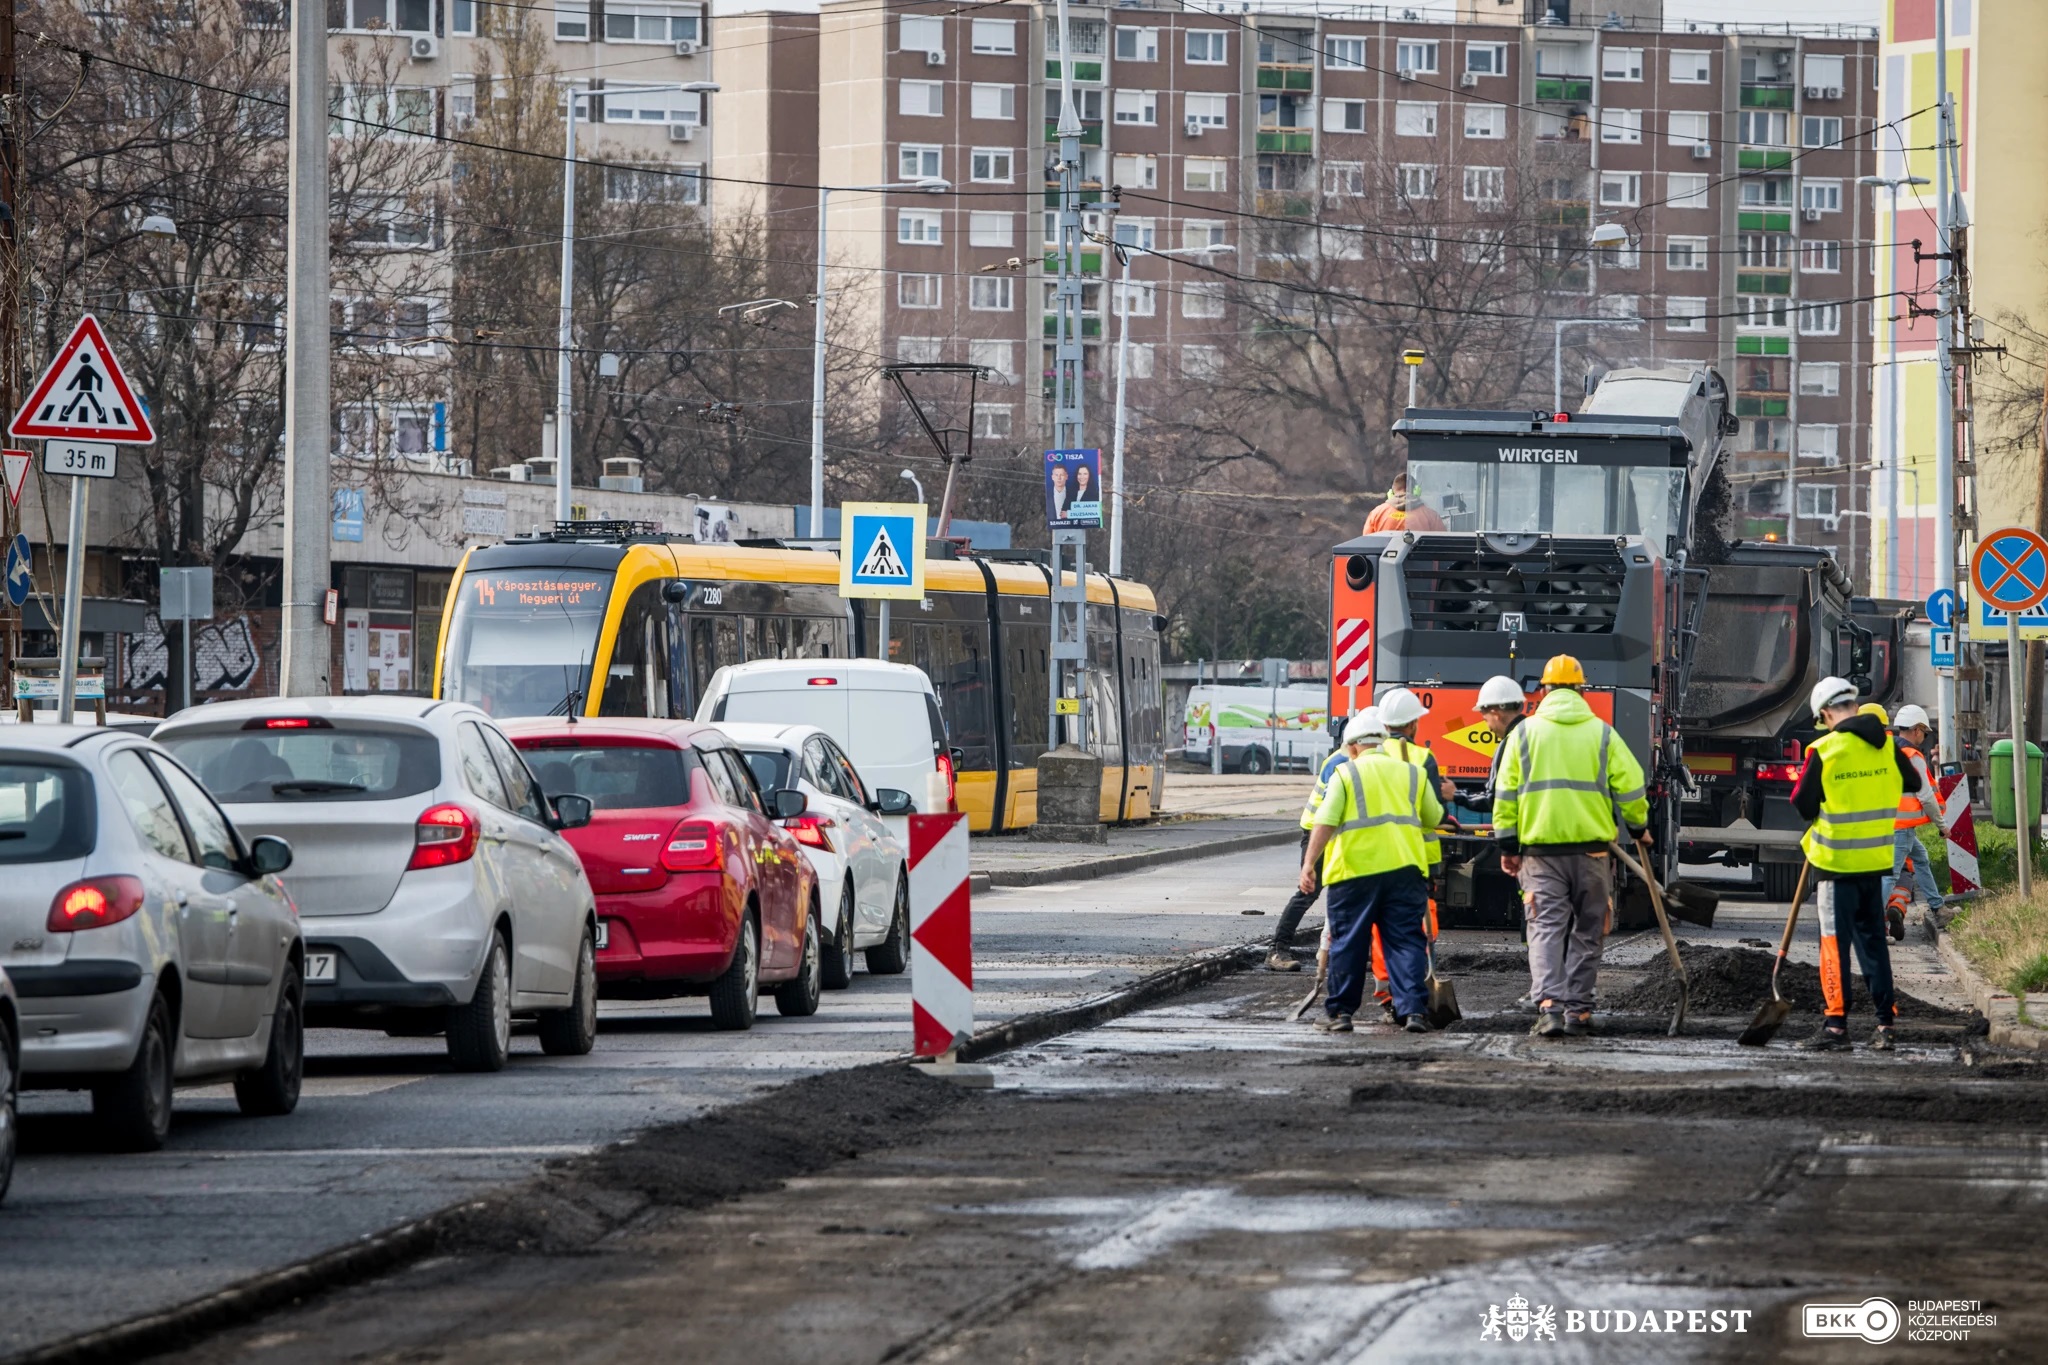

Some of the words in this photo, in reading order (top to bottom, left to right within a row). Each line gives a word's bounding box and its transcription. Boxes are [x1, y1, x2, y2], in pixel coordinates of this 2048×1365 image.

[65, 448, 86, 469] 35
[91, 455, 106, 470] m
[1498, 448, 1578, 463] WIRTGEN
[474, 578, 495, 605] 14
[496, 580, 602, 592] Káposztásmegyer,
[519, 593, 563, 604] Megyeri
[568, 592, 580, 603] út
[703, 587, 722, 605] 2280
[1468, 731, 1501, 744] COL
[1692, 774, 1717, 782] LLER
[1834, 771, 1857, 781] HERO
[623, 833, 660, 841] SWIFT
